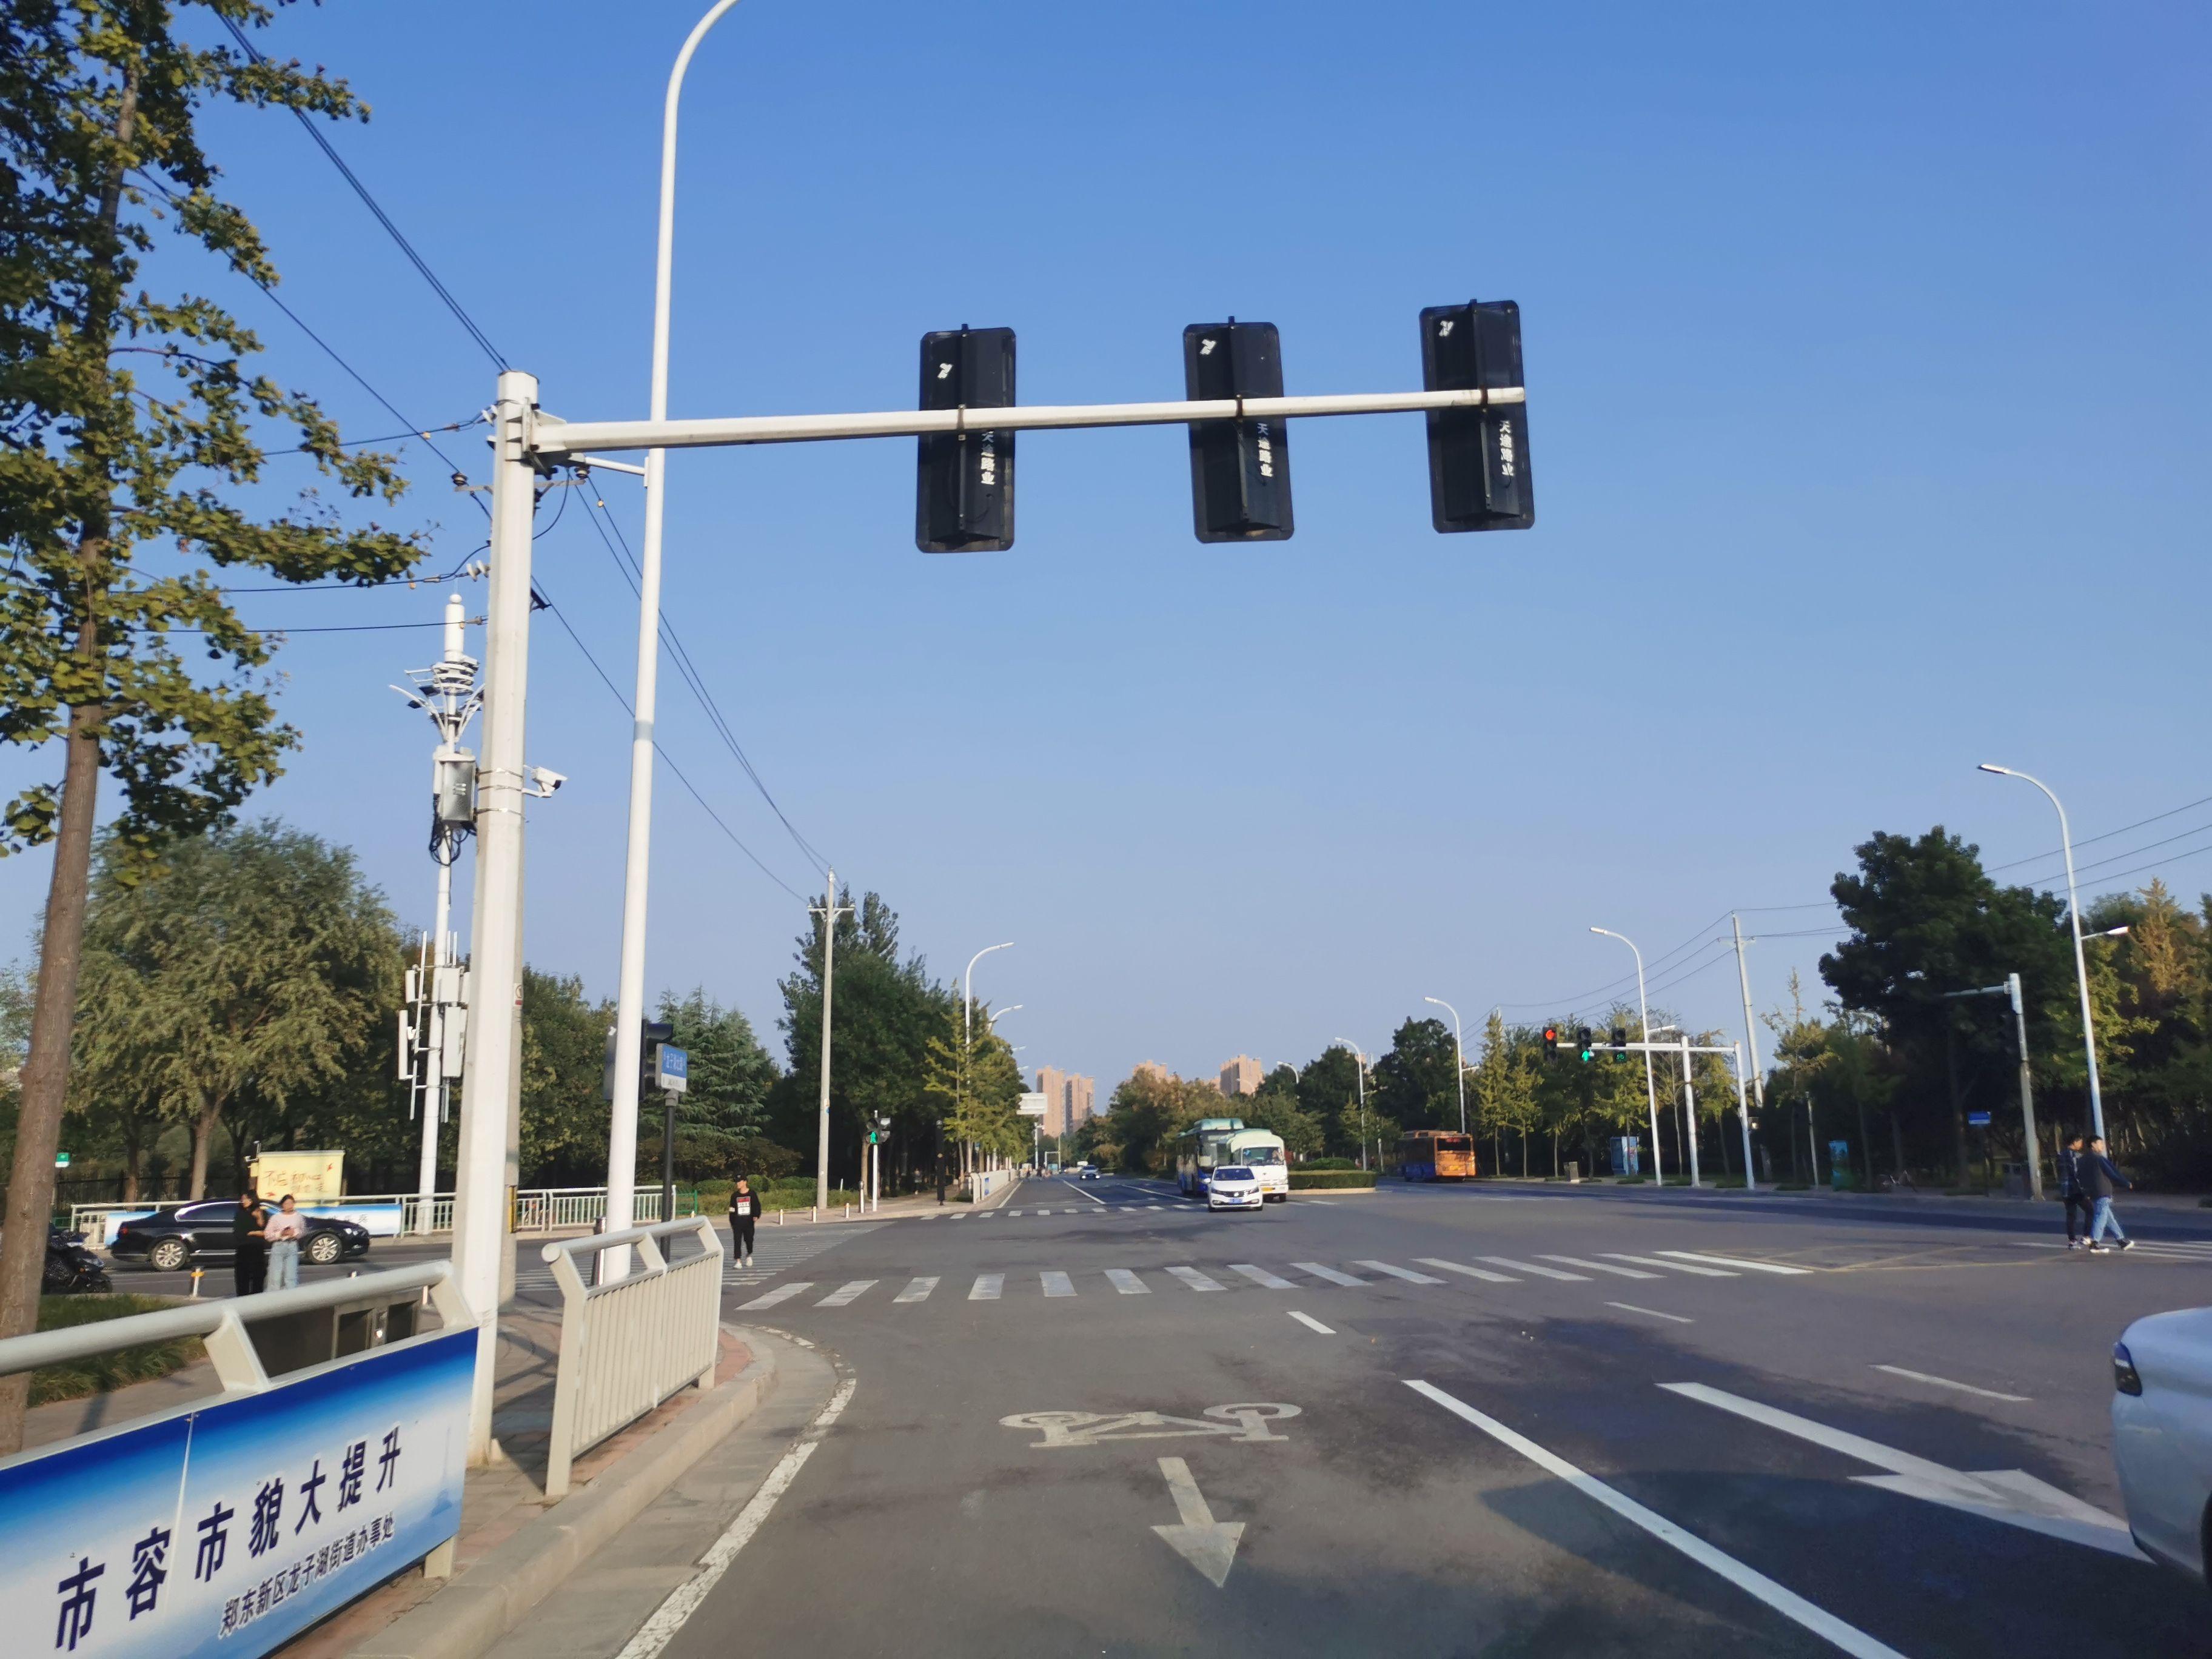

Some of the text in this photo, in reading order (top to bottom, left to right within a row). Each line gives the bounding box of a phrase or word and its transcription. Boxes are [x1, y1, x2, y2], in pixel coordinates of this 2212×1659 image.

[55, 1425, 401, 1652] 市容市貌大提升
[219, 1510, 394, 1637] 郑东新区龙子湖街道办事处
